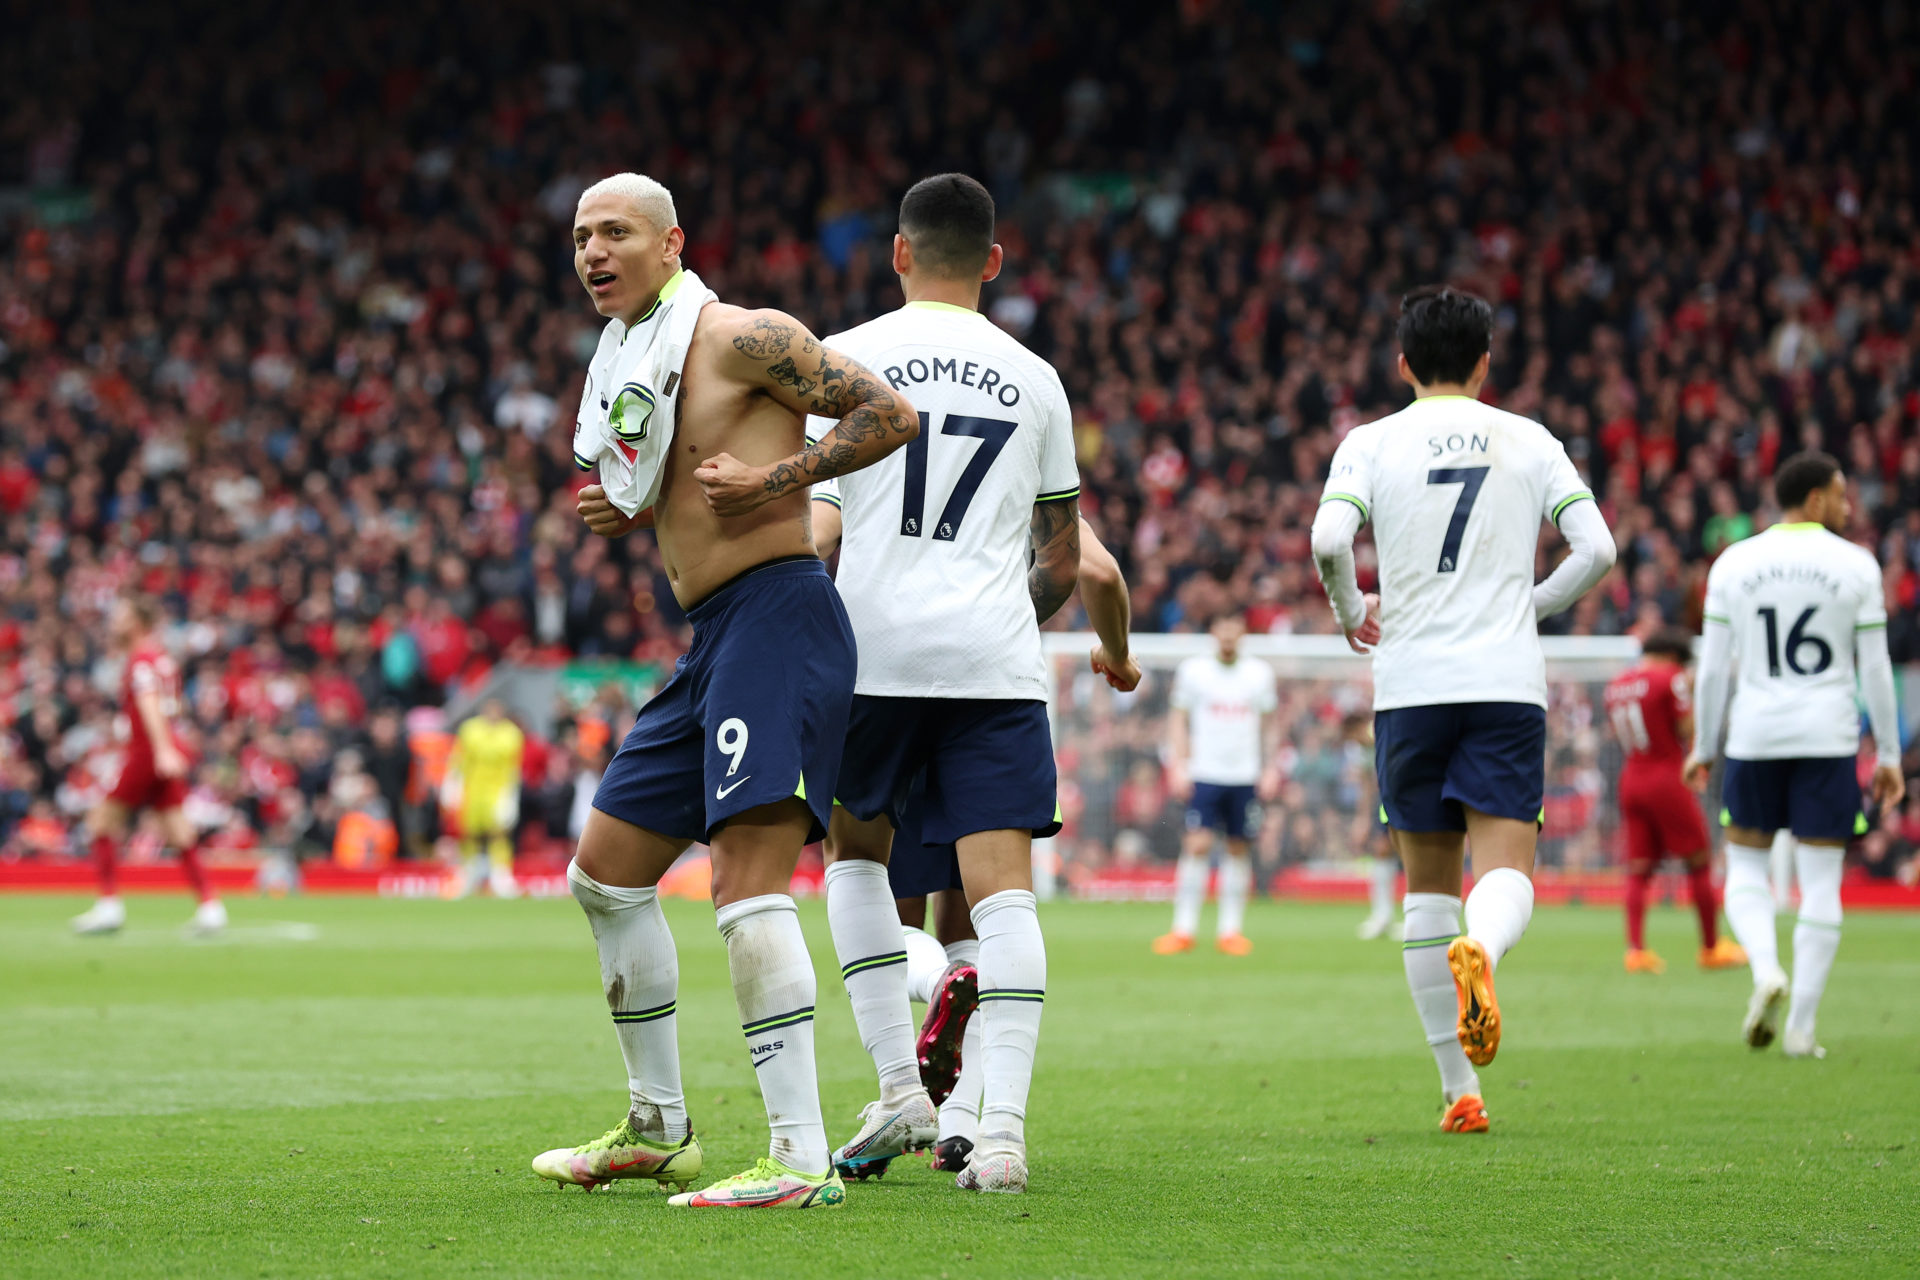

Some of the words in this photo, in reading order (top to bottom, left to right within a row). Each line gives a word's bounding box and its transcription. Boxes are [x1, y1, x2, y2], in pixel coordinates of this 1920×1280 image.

[883, 357, 1021, 408] ROMERO
[900, 410, 1019, 542] 17
[1428, 433, 1489, 457] SON
[1427, 465, 1492, 573] 7
[1757, 605, 1833, 677] 16
[717, 717, 749, 778] 9
